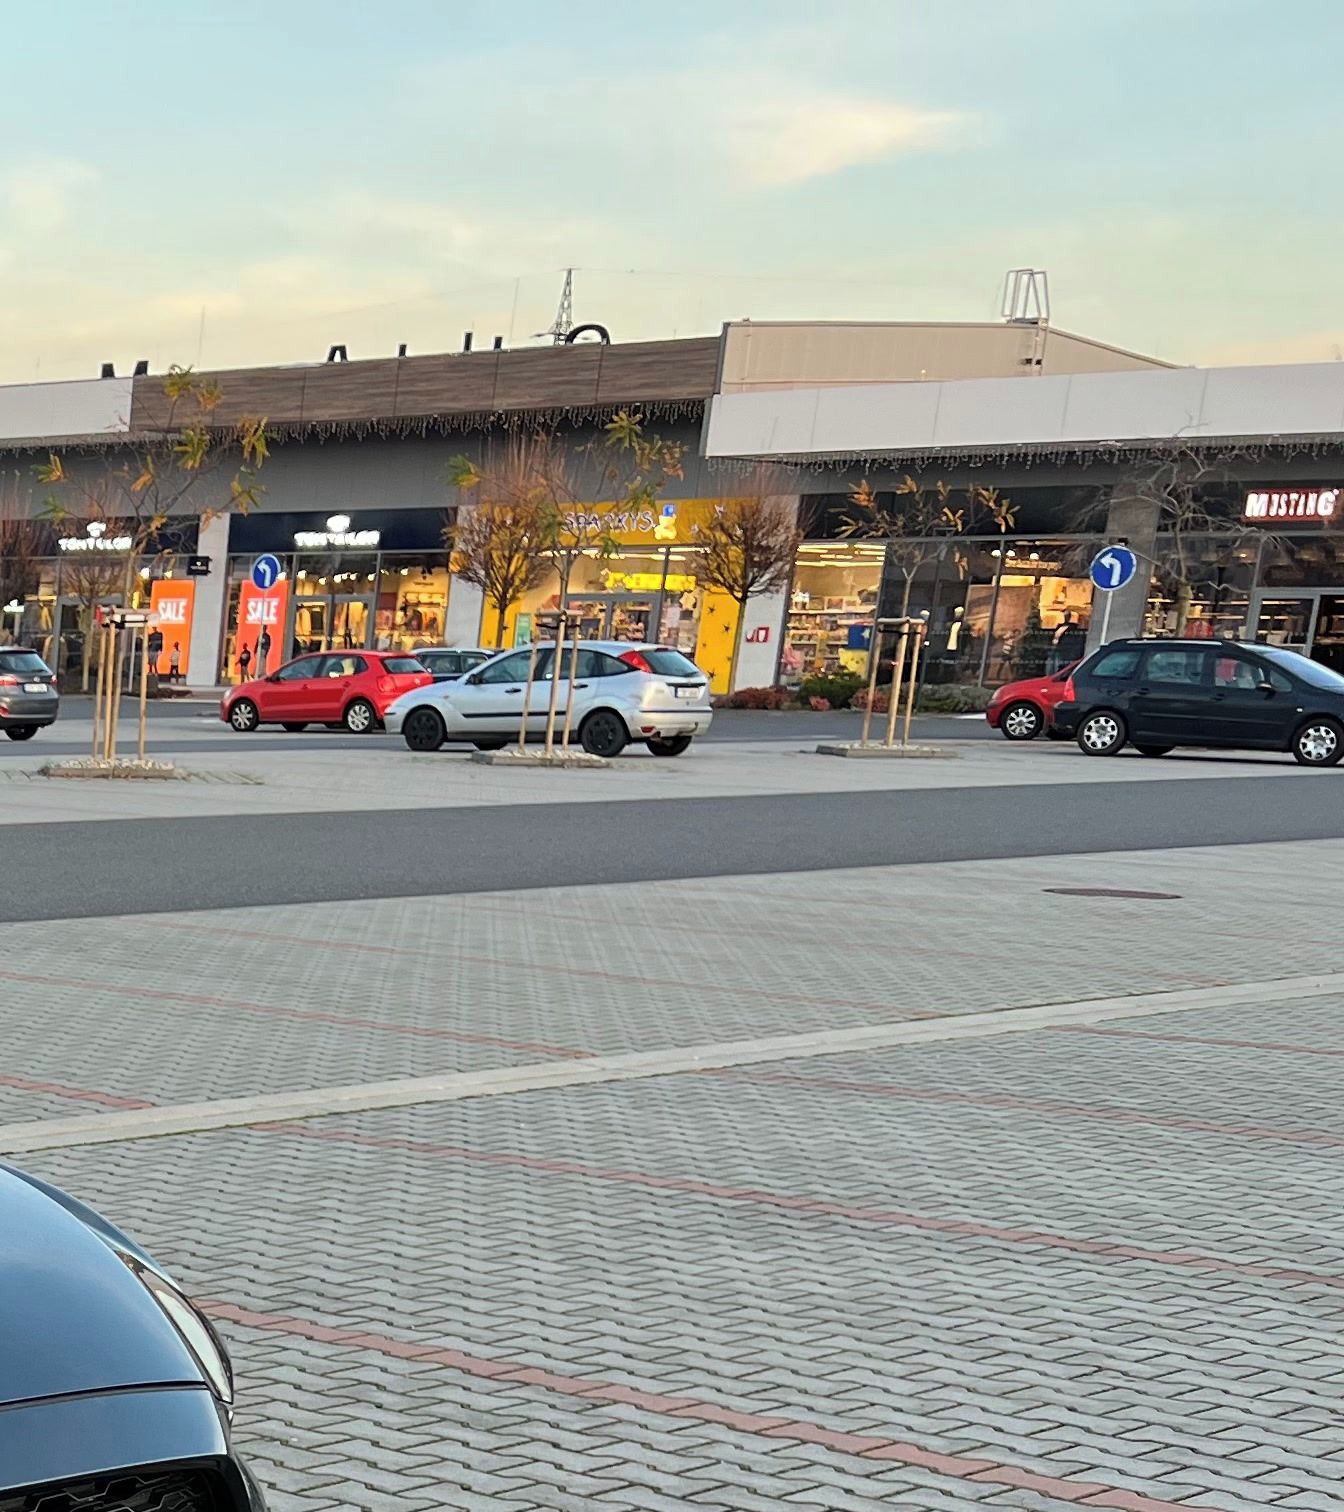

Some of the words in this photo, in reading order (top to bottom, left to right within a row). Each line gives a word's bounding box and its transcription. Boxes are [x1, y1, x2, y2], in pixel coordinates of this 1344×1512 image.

[1245, 491, 1336, 517] MUSTANG
[158, 601, 187, 622] SALE
[247, 599, 278, 622] SALE
